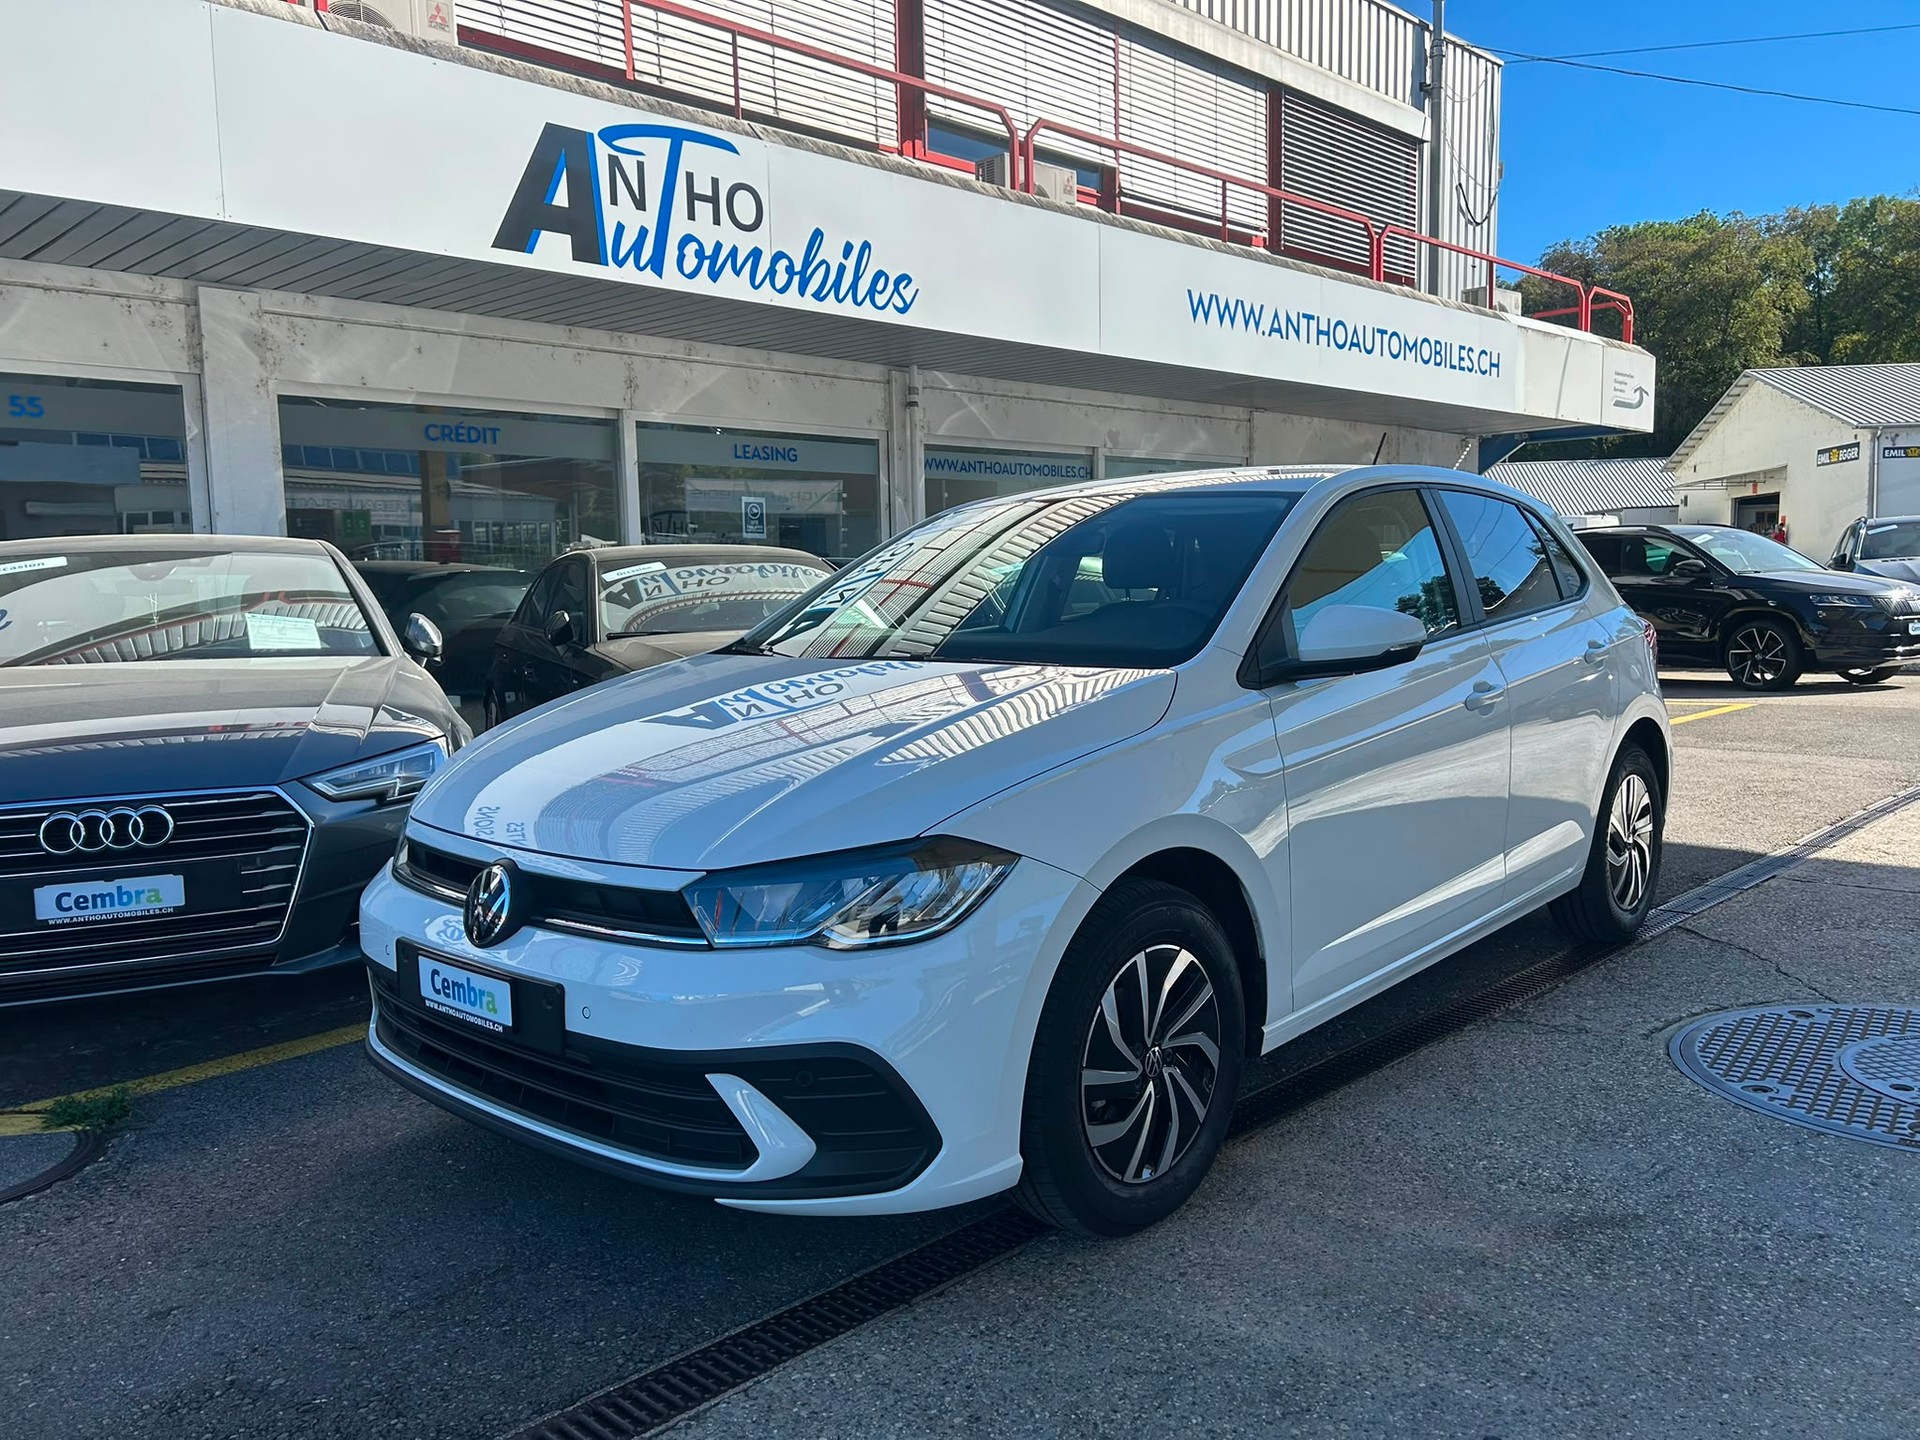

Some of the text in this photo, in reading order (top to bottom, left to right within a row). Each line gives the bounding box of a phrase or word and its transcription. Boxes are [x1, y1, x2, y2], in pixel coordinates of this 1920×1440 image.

[1186, 289, 1501, 378] WWW.ANTHOAUTOMOBILES.CH
[9, 395, 45, 418] 55
[423, 422, 501, 445] CRÉDIT
[733, 443, 798, 463] LEASING
[1817, 447, 1859, 465] EMIL EGGER
[1884, 449, 1906, 457] EMIL
[924, 458, 1093, 479] WWW.ANTHOAUTOMOBILES.CH
[0, 562, 45, 573] casion
[54, 885, 164, 912] Cembra
[48, 907, 174, 925] WWW.ANTHOAUTOMOBILES.CH
[430, 968, 498, 1015] Cembra
[425, 999, 503, 1033] WWW.ANTHOAUTOMOBILES.CH
